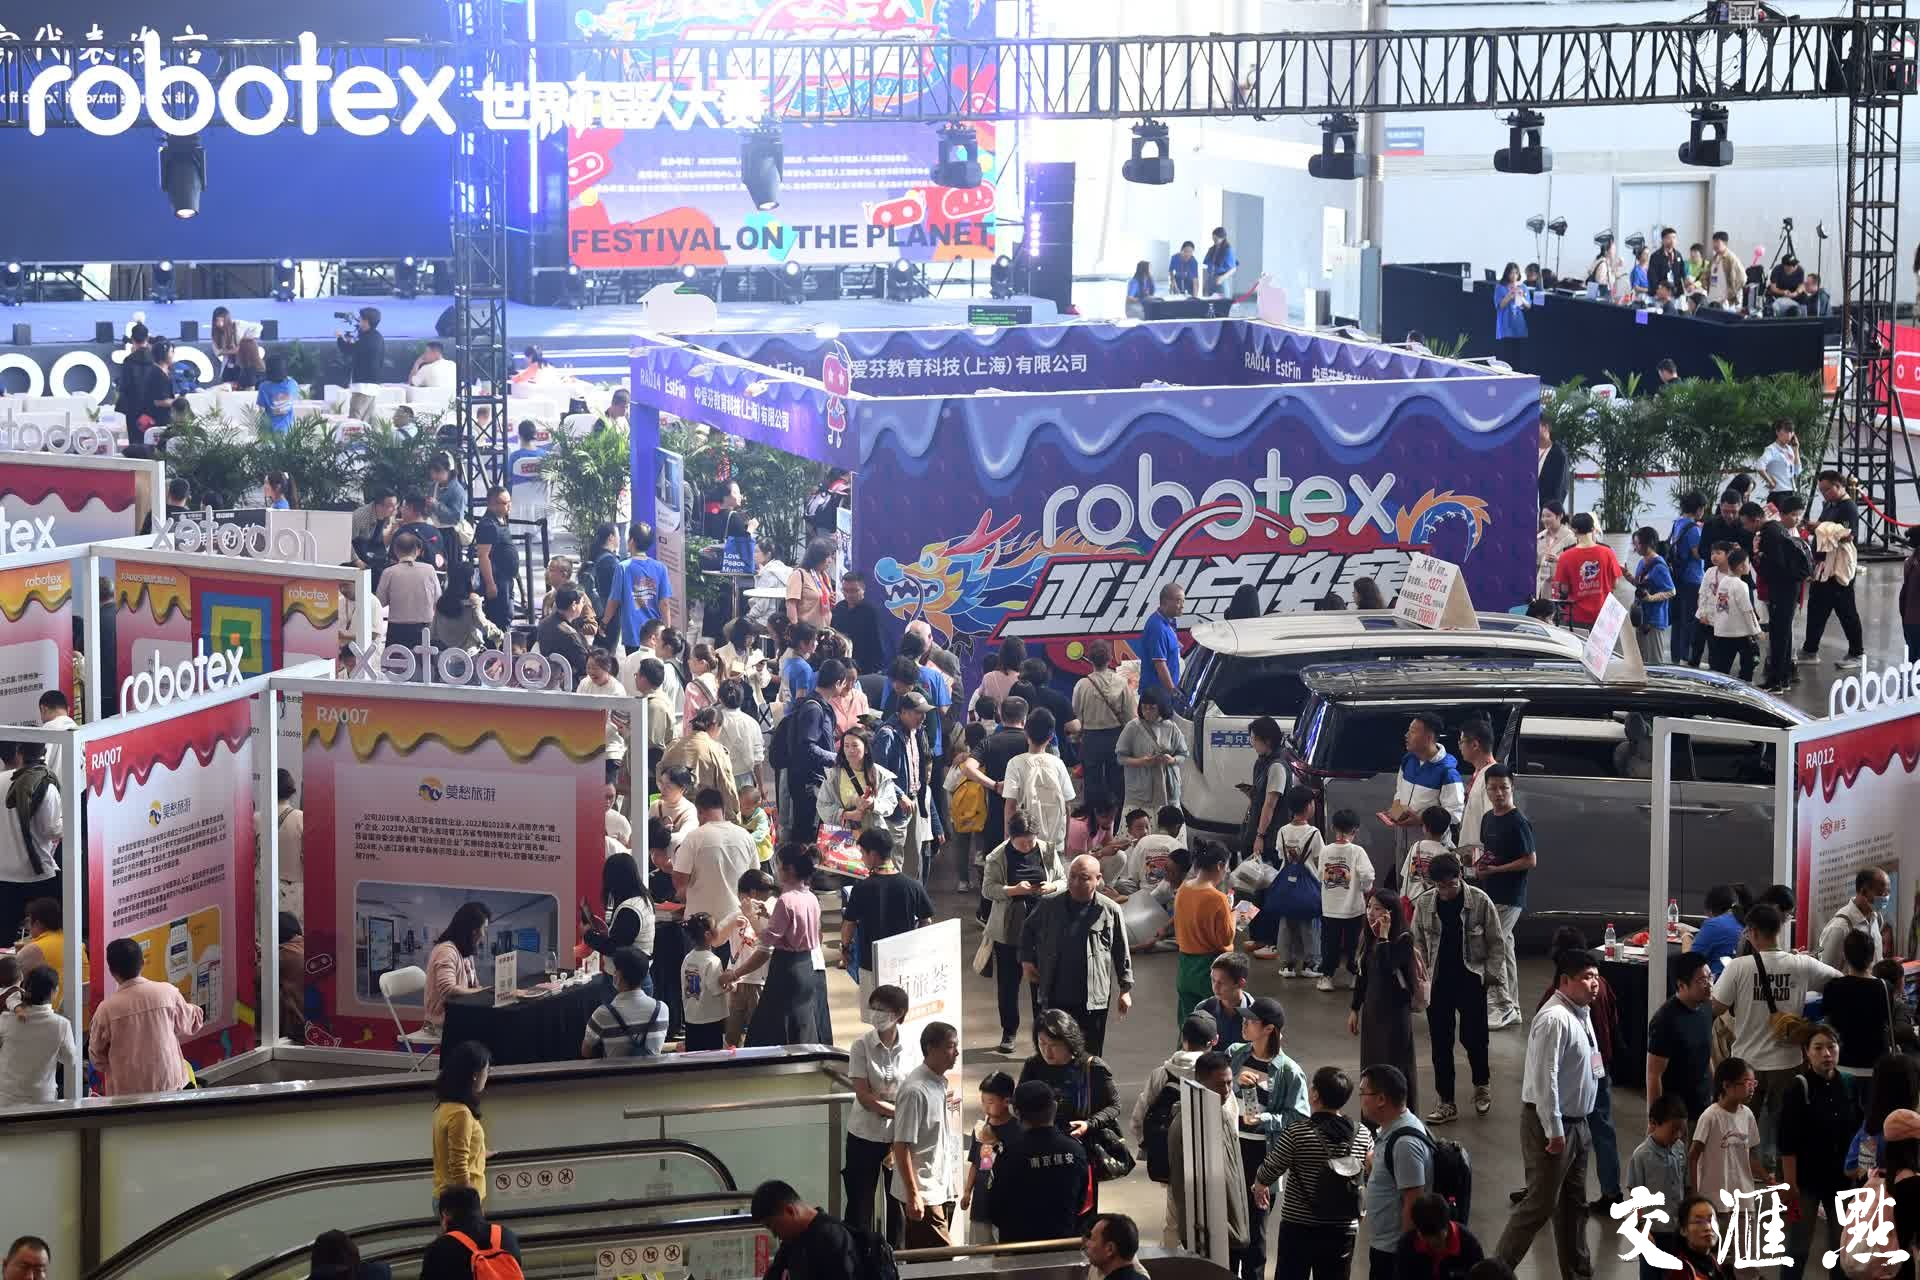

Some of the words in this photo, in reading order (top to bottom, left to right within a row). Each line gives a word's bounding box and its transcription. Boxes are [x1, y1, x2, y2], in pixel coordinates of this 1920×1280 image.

[28, 31, 457, 137] robotex
[571, 227, 731, 254] FESTIVAL
[736, 226, 785, 252] ON
[791, 224, 858, 250] THE
[865, 222, 994, 248] PLANET
[1245, 351, 1270, 373] RA014
[1276, 359, 1301, 380] EstFin
[665, 375, 686, 400] EstFin
[1043, 448, 1396, 547] robotex
[288, 585, 329, 601] robotex
[120, 638, 244, 718] robotex
[316, 705, 369, 725] RA007
[92, 746, 122, 769] RA007
[1806, 747, 1834, 769] RA012
[445, 784, 496, 802] 莫愁旅游
[1030, 1152, 1074, 1169] 南京保安
